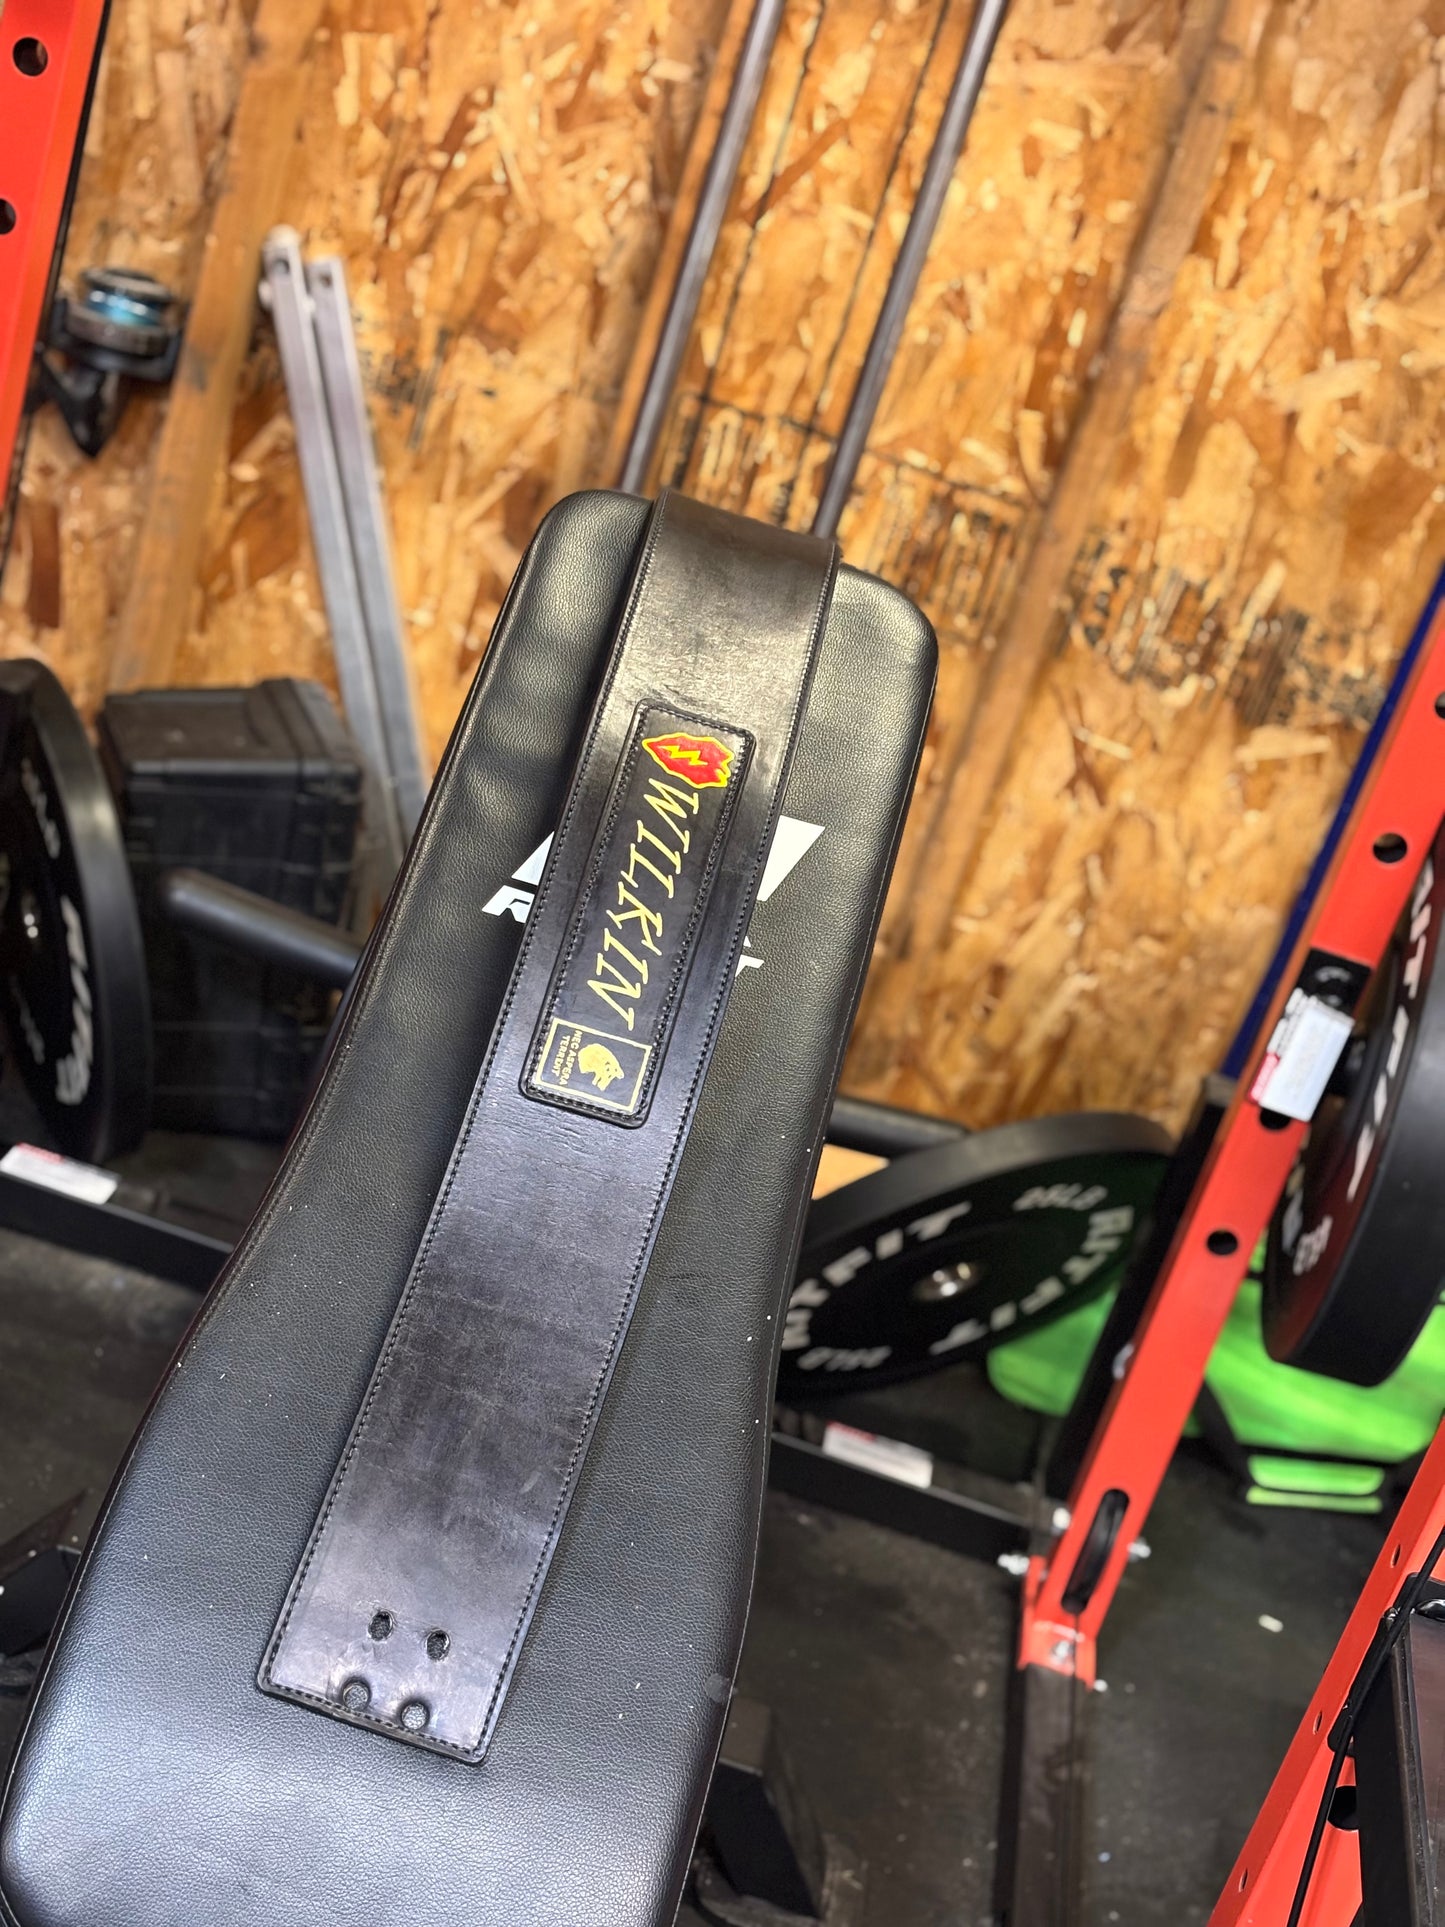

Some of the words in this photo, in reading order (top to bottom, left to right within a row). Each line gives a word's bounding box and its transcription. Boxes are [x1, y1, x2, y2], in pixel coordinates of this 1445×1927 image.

[587, 778, 699, 1031] WILKIN
[552, 1035, 570, 1077] TERRENT
[571, 1029, 583, 1050] NEC
[559, 1050, 577, 1085] ASPERA
